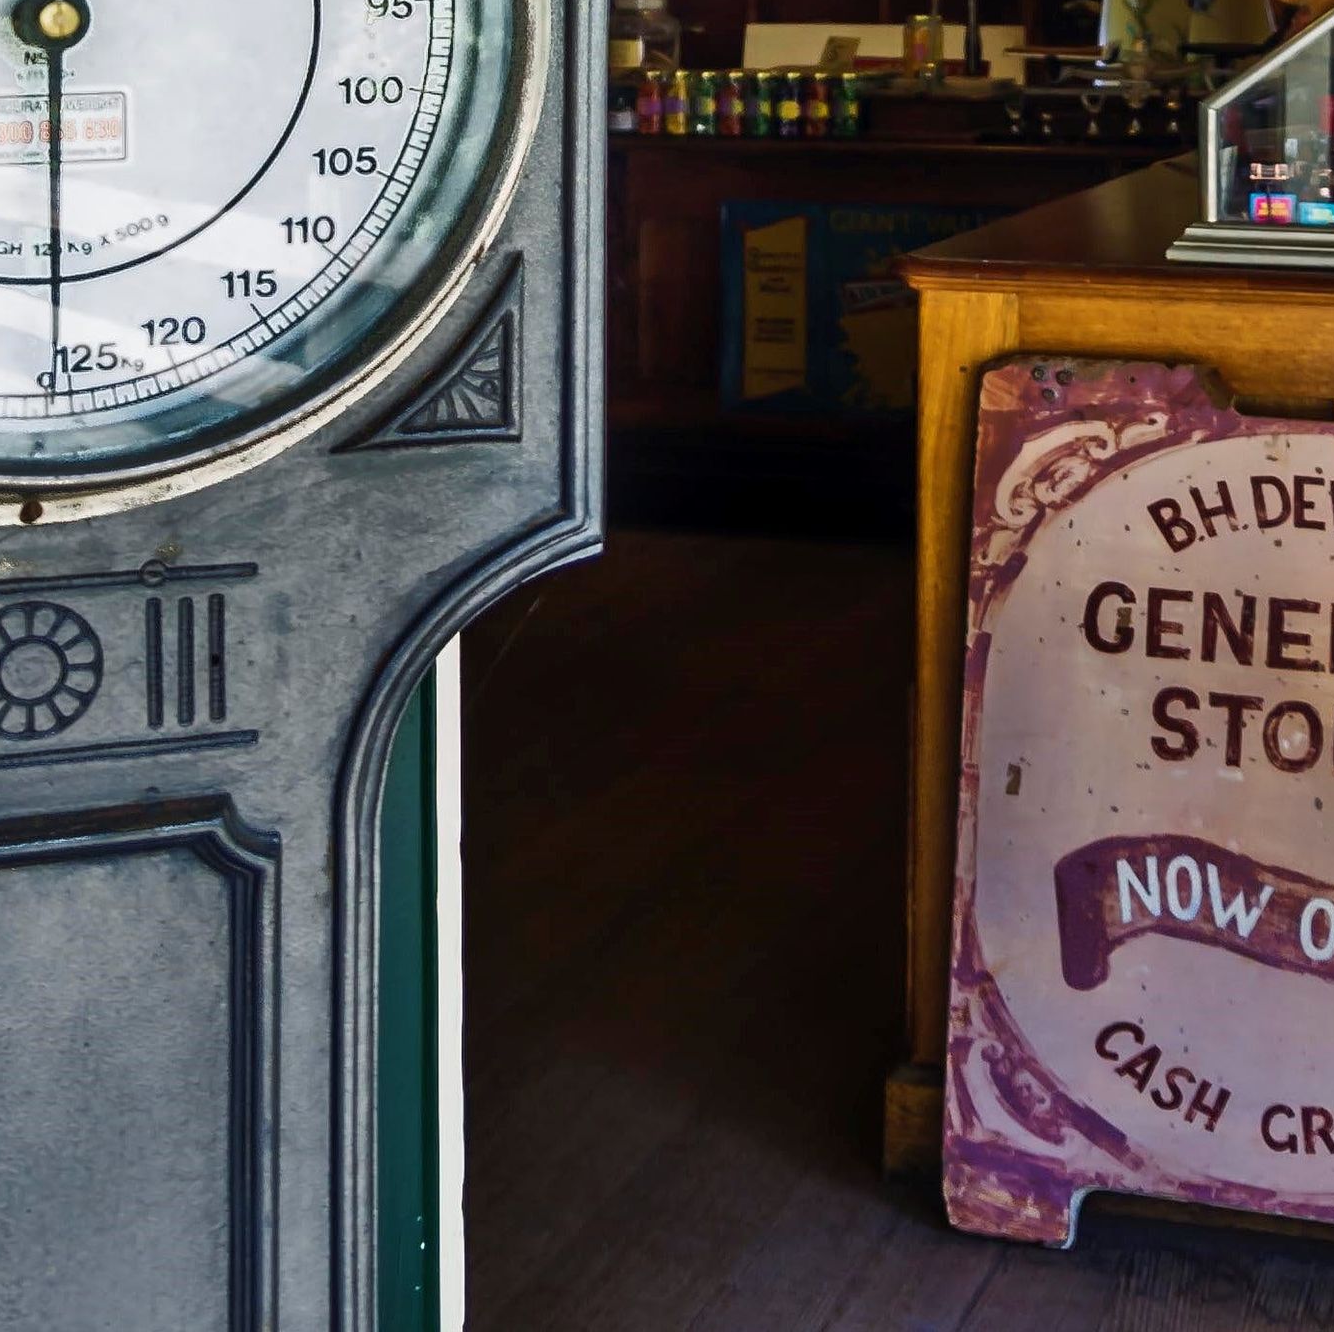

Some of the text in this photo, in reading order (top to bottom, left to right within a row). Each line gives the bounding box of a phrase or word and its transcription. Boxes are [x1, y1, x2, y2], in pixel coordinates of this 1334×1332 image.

[337, 75, 405, 105] 100
[312, 147, 378, 177] 105
[280, 215, 337, 245] 110
[32, 242, 63, 257] 12
[219, 269, 278, 300] 115
[141, 314, 206, 346] 120
[1114, 853, 1275, 940] NOW
[1093, 1019, 1233, 1135] CASH
